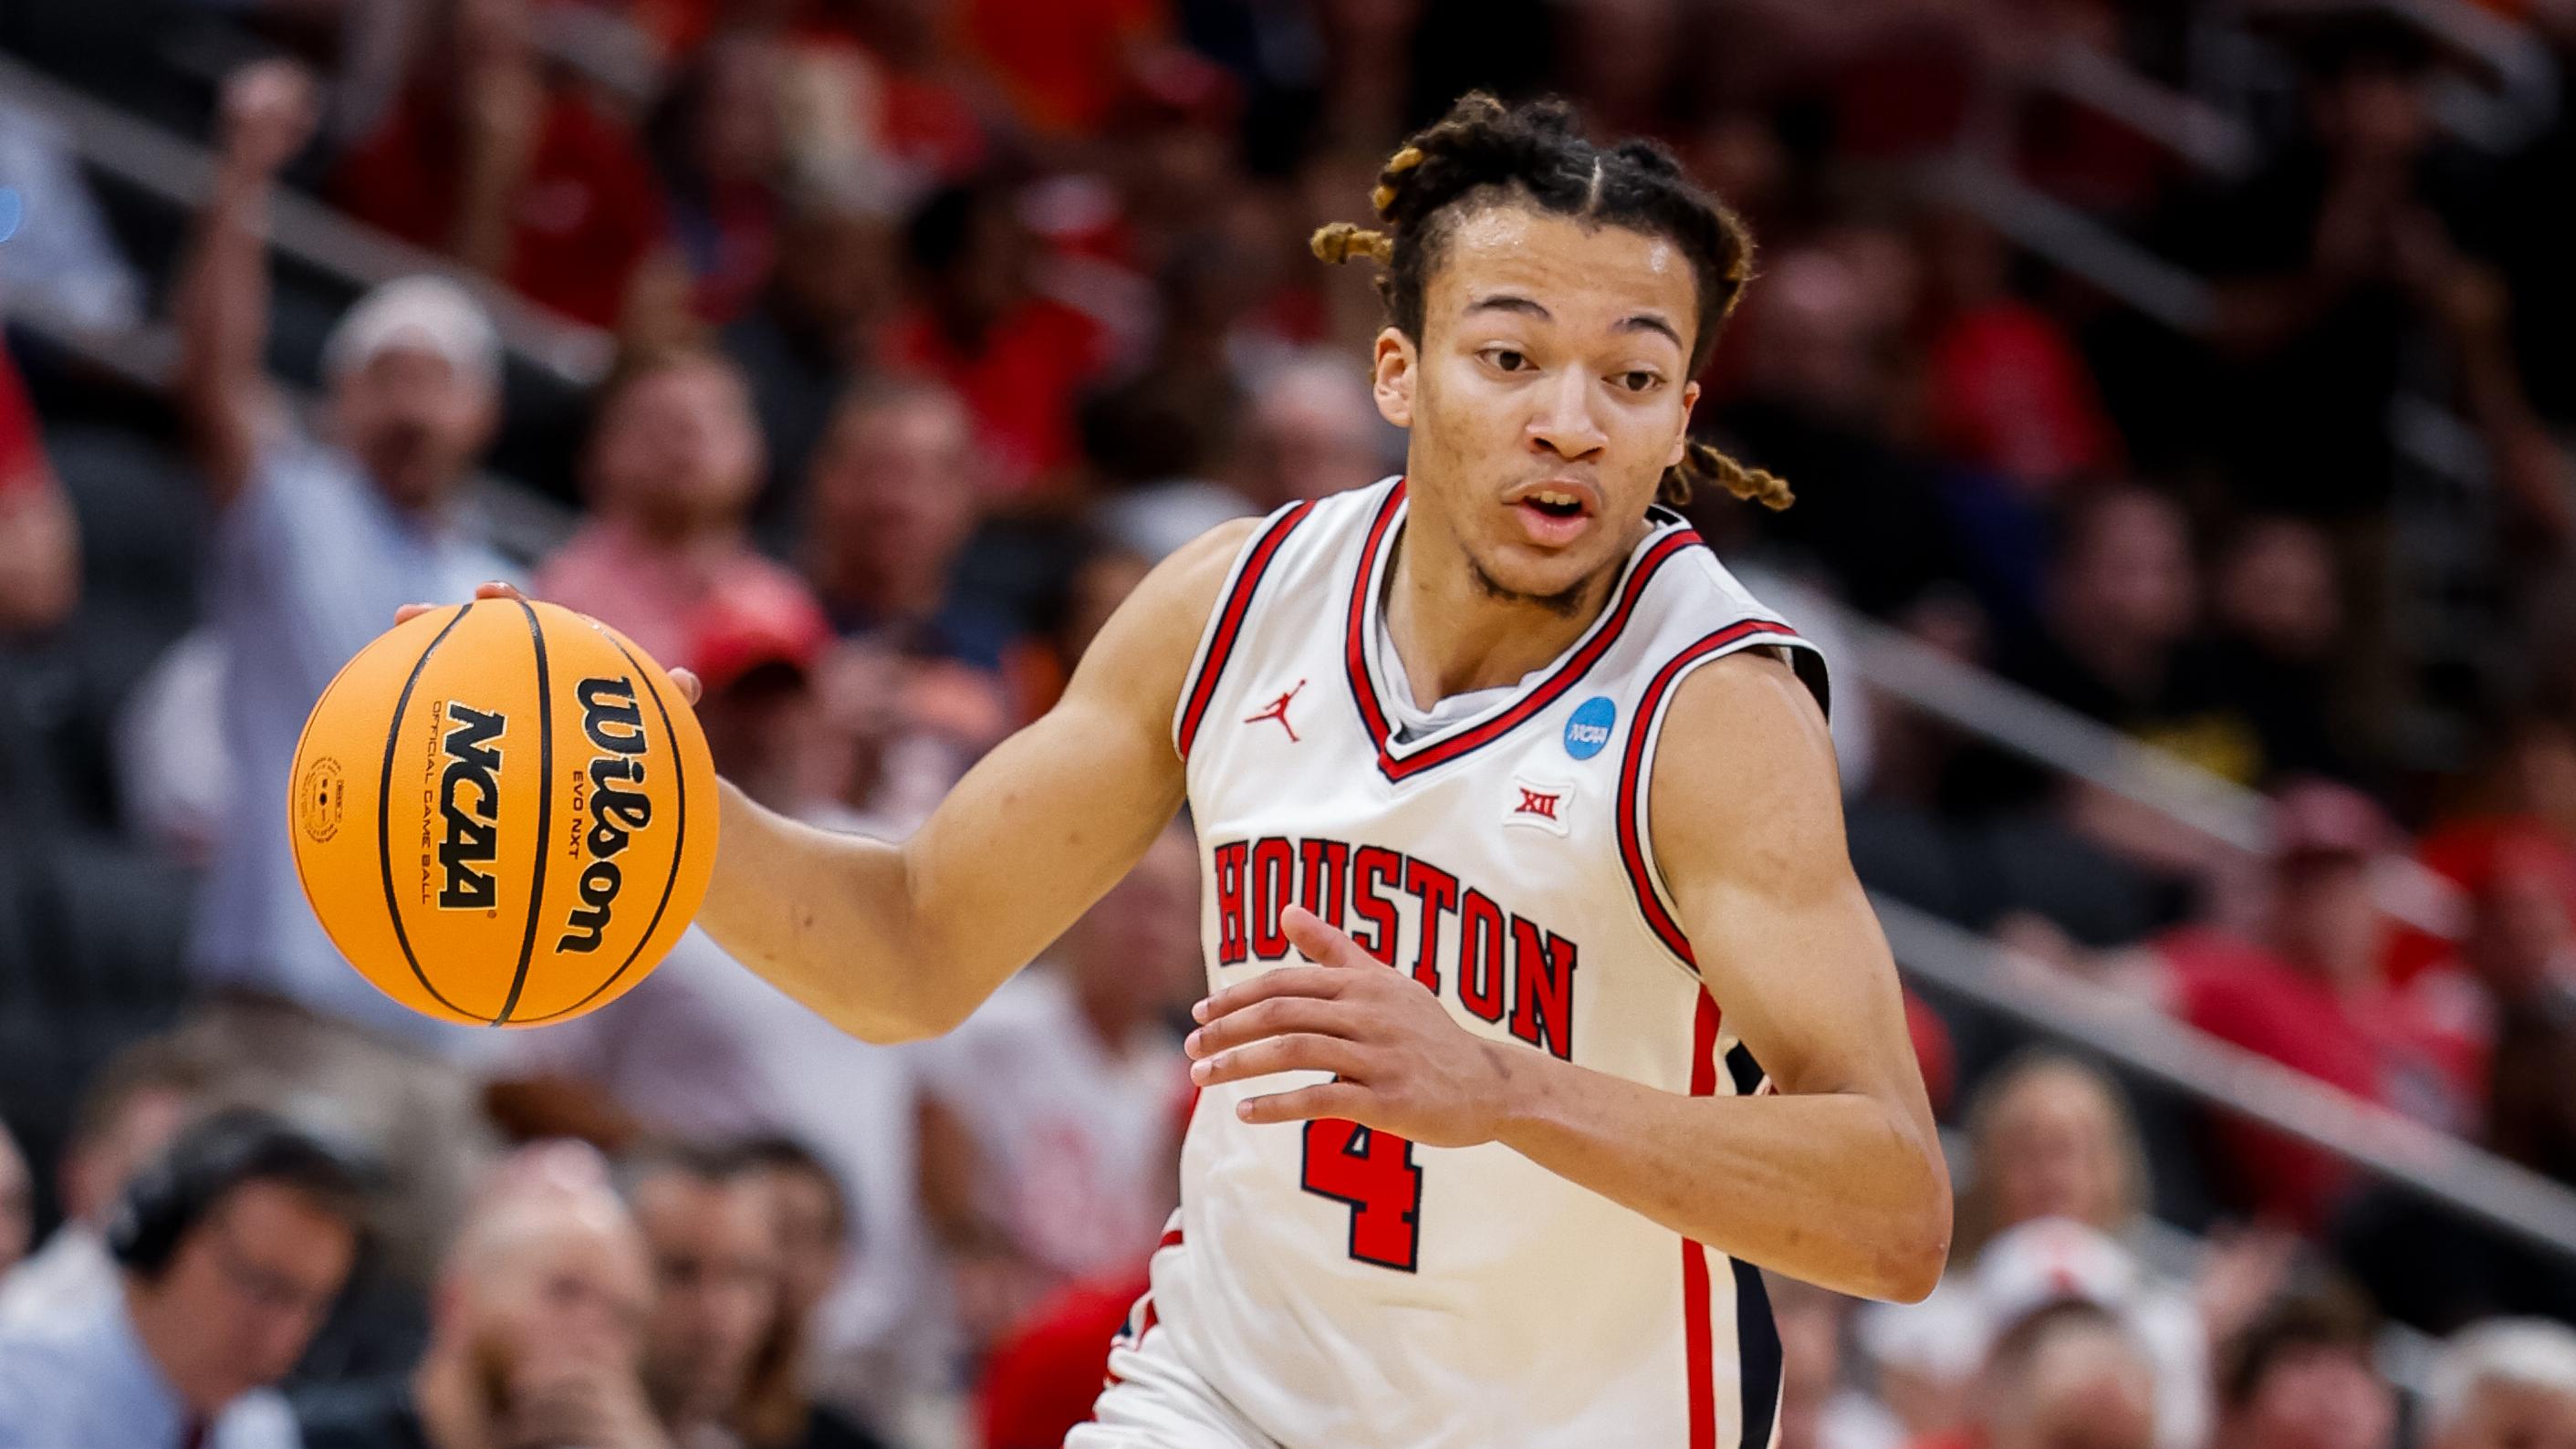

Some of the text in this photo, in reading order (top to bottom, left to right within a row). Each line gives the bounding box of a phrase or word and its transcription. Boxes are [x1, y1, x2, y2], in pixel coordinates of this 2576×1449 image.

[421, 700, 442, 905] OFFICIAL GAME BALL
[438, 700, 508, 911] NCAA
[556, 675, 652, 954] Wilson
[568, 770, 584, 860] EVO NXT
[1515, 787, 1561, 821] XII
[1568, 723, 1610, 745] NCAA
[1215, 836, 1578, 1062] HOUSTON
[1300, 1077, 1423, 1274] 4
